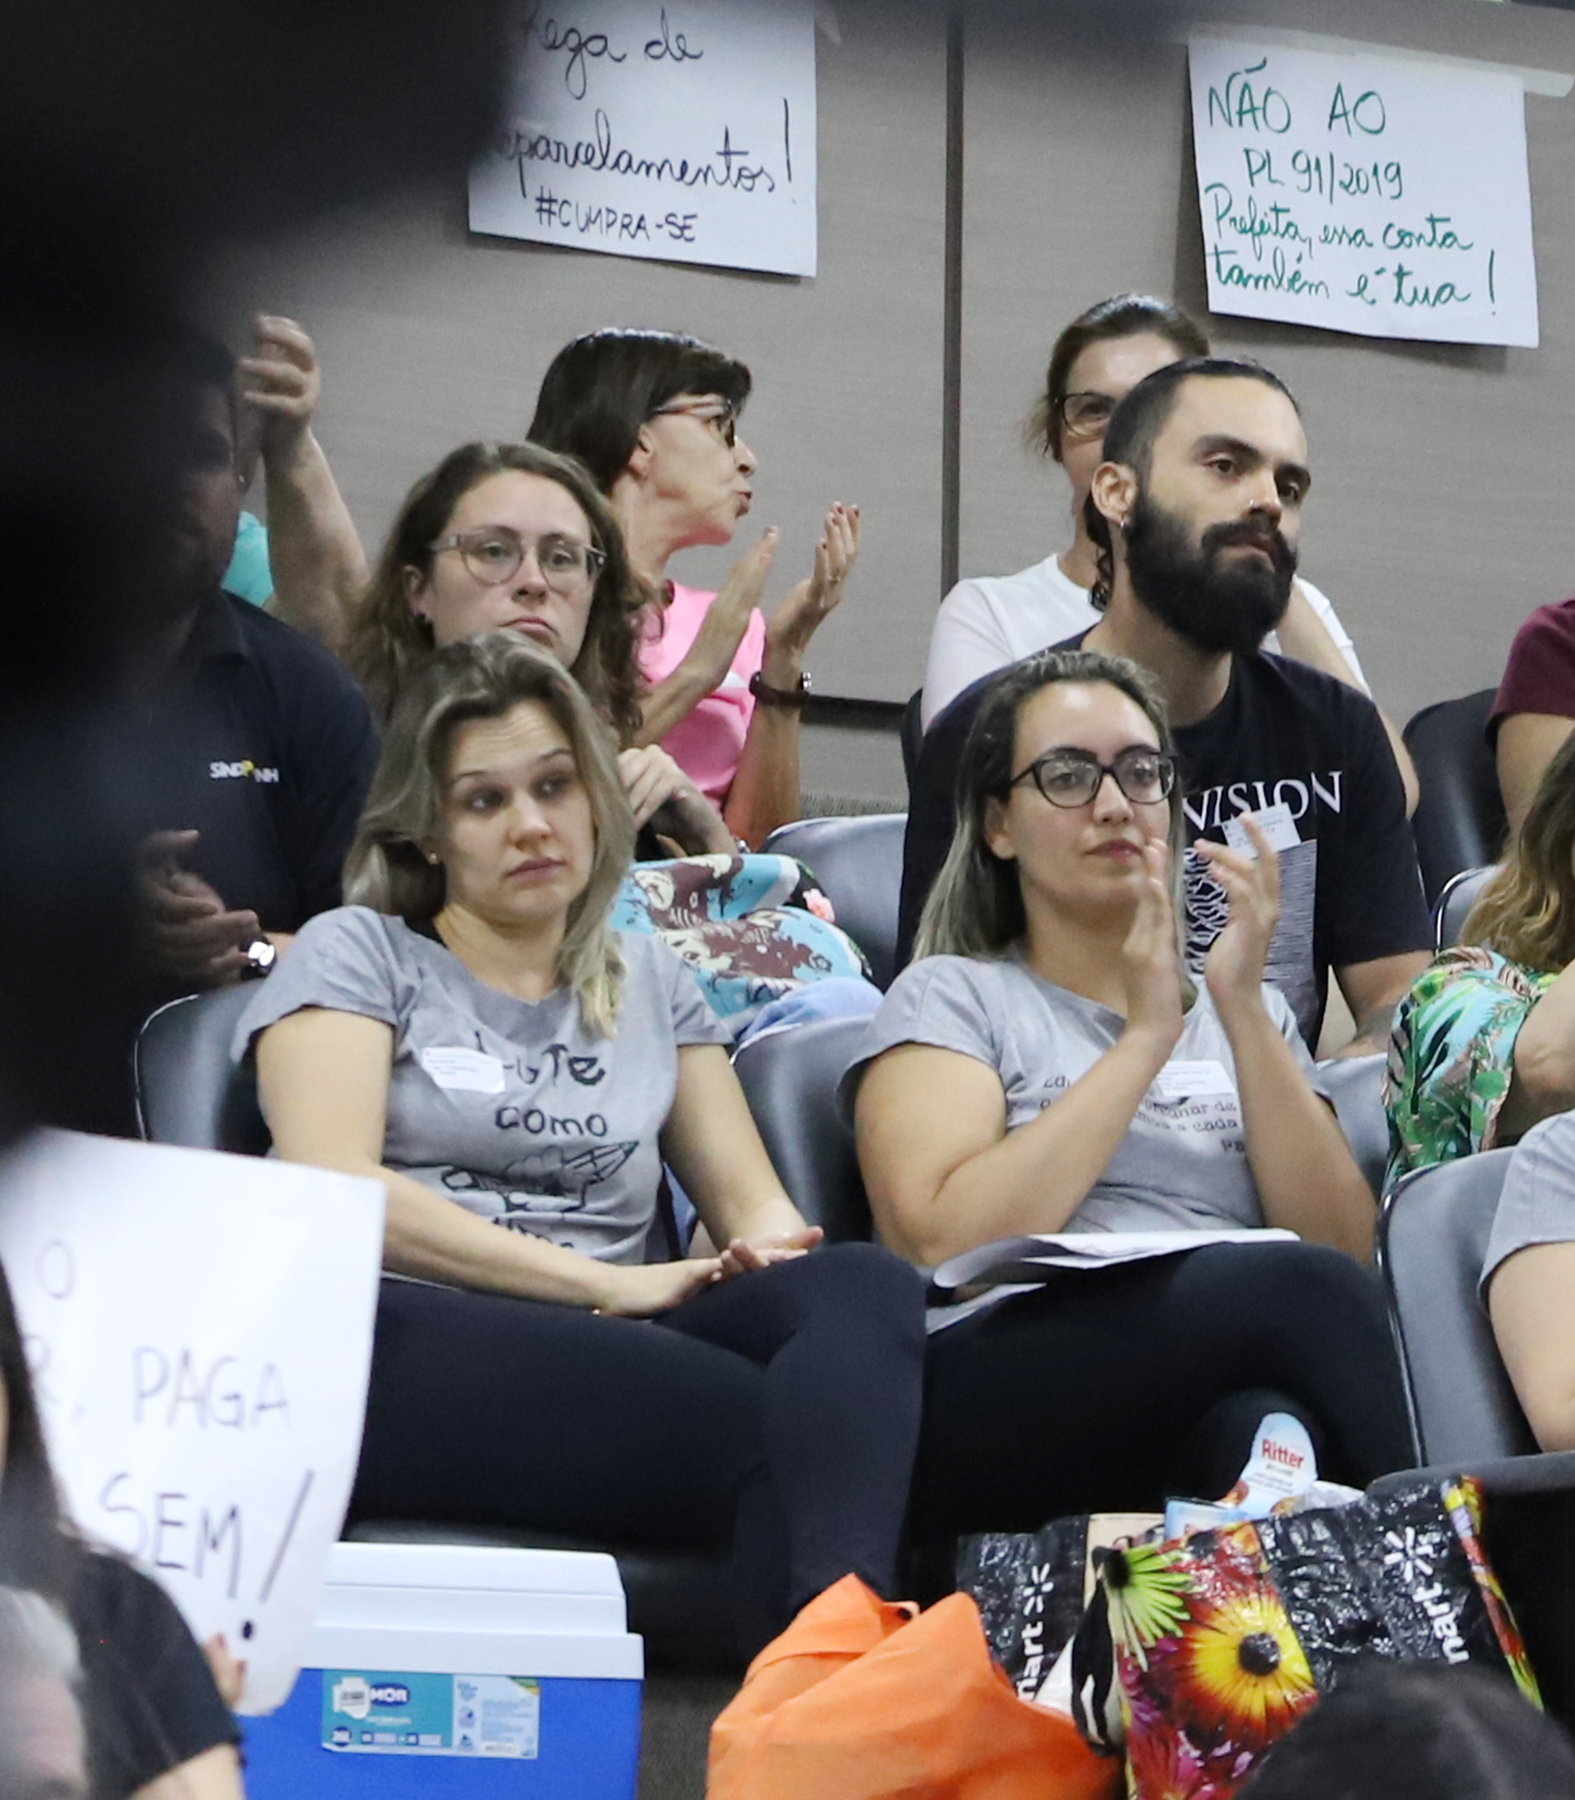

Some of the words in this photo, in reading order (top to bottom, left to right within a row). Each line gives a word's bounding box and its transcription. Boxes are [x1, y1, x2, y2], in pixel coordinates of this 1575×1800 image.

[643, 8, 704, 62] de
[1207, 56, 1293, 134] NÃO
[1327, 81, 1387, 137] AO
[534, 185, 700, 243] #CUMPRA-SE
[1382, 212, 1476, 253] conta
[1181, 770, 1343, 832] VISION
[131, 1343, 291, 1430] PAGA
[1261, 1439, 1305, 1469] Ritter
